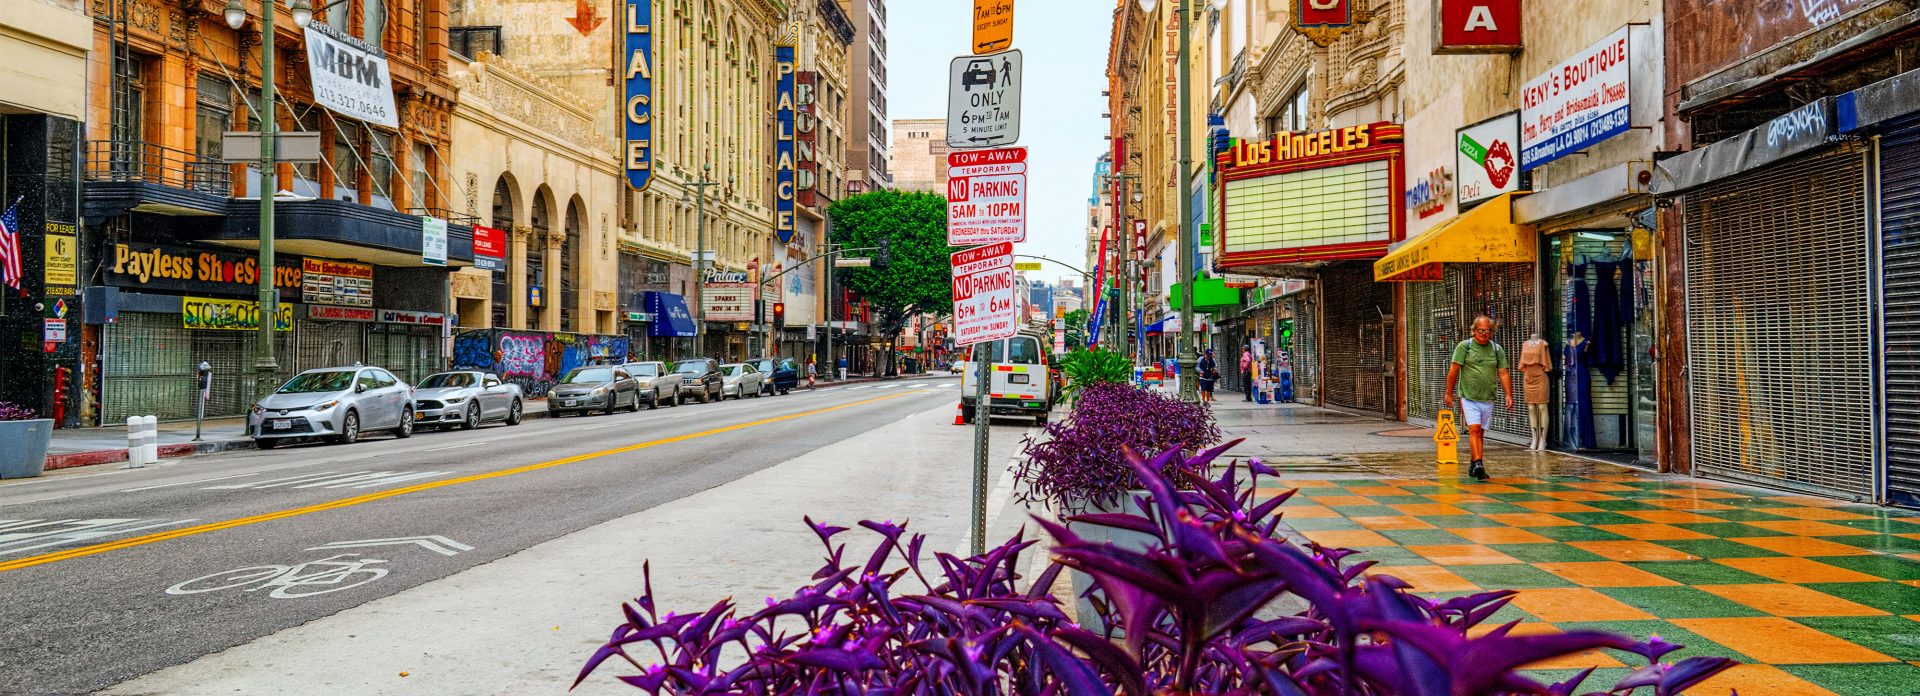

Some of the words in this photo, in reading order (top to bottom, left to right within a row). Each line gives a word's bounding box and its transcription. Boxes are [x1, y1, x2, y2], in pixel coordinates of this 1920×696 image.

[976, 6, 990, 20] 7AM
[996, 1, 1011, 16] 6PM
[976, 21, 991, 31] EXCEPT
[992, 17, 1008, 28] SUNDAY
[311, 19, 338, 38] GENERAL
[339, 32, 378, 54] CONTRACTORS
[1523, 72, 1559, 112] KENY'S
[1563, 38, 1625, 91] BOUTIQUE
[626, 3, 651, 170] LACE
[318, 85, 386, 118] 213.327.0646
[970, 89, 1004, 107] ONLY
[961, 110, 985, 124] 6PM
[993, 107, 1010, 122] 7AM
[1554, 105, 1564, 123] and
[796, 83, 815, 191] BOND
[963, 126, 968, 134] 5
[971, 124, 993, 133] MINUTE
[994, 122, 1008, 132] LIMIT
[776, 61, 794, 231] PALACE
[1460, 141, 1479, 160] PIZZA
[954, 150, 1020, 164] TOW-AWAY
[962, 165, 1011, 175] TEMPORARY
[950, 179, 967, 200] NO
[973, 180, 1018, 199] PARKING
[1461, 180, 1481, 200] Deli
[952, 204, 976, 219] 5AM
[986, 202, 1020, 217] 10PM
[46, 222, 59, 232] FOR
[59, 224, 76, 234] LEASE
[990, 226, 1018, 235] SATURDAY
[957, 244, 1005, 264] TOW-AWAY
[113, 243, 193, 284] Payless
[197, 252, 302, 288] ShoeSrce
[304, 259, 321, 273] Max
[703, 265, 747, 284] Palace
[960, 257, 1004, 274] TEMPORARY
[955, 276, 971, 299] NO
[973, 271, 1010, 295] PARKING
[236, 304, 291, 329] CLONG
[325, 307, 343, 318] MUSIC
[344, 308, 374, 320] EQUIPMENT
[957, 302, 975, 320] 6PM
[989, 295, 1010, 313] 6AM
[961, 325, 981, 336] SATURDAY
[990, 321, 1008, 331] SUNDAY
